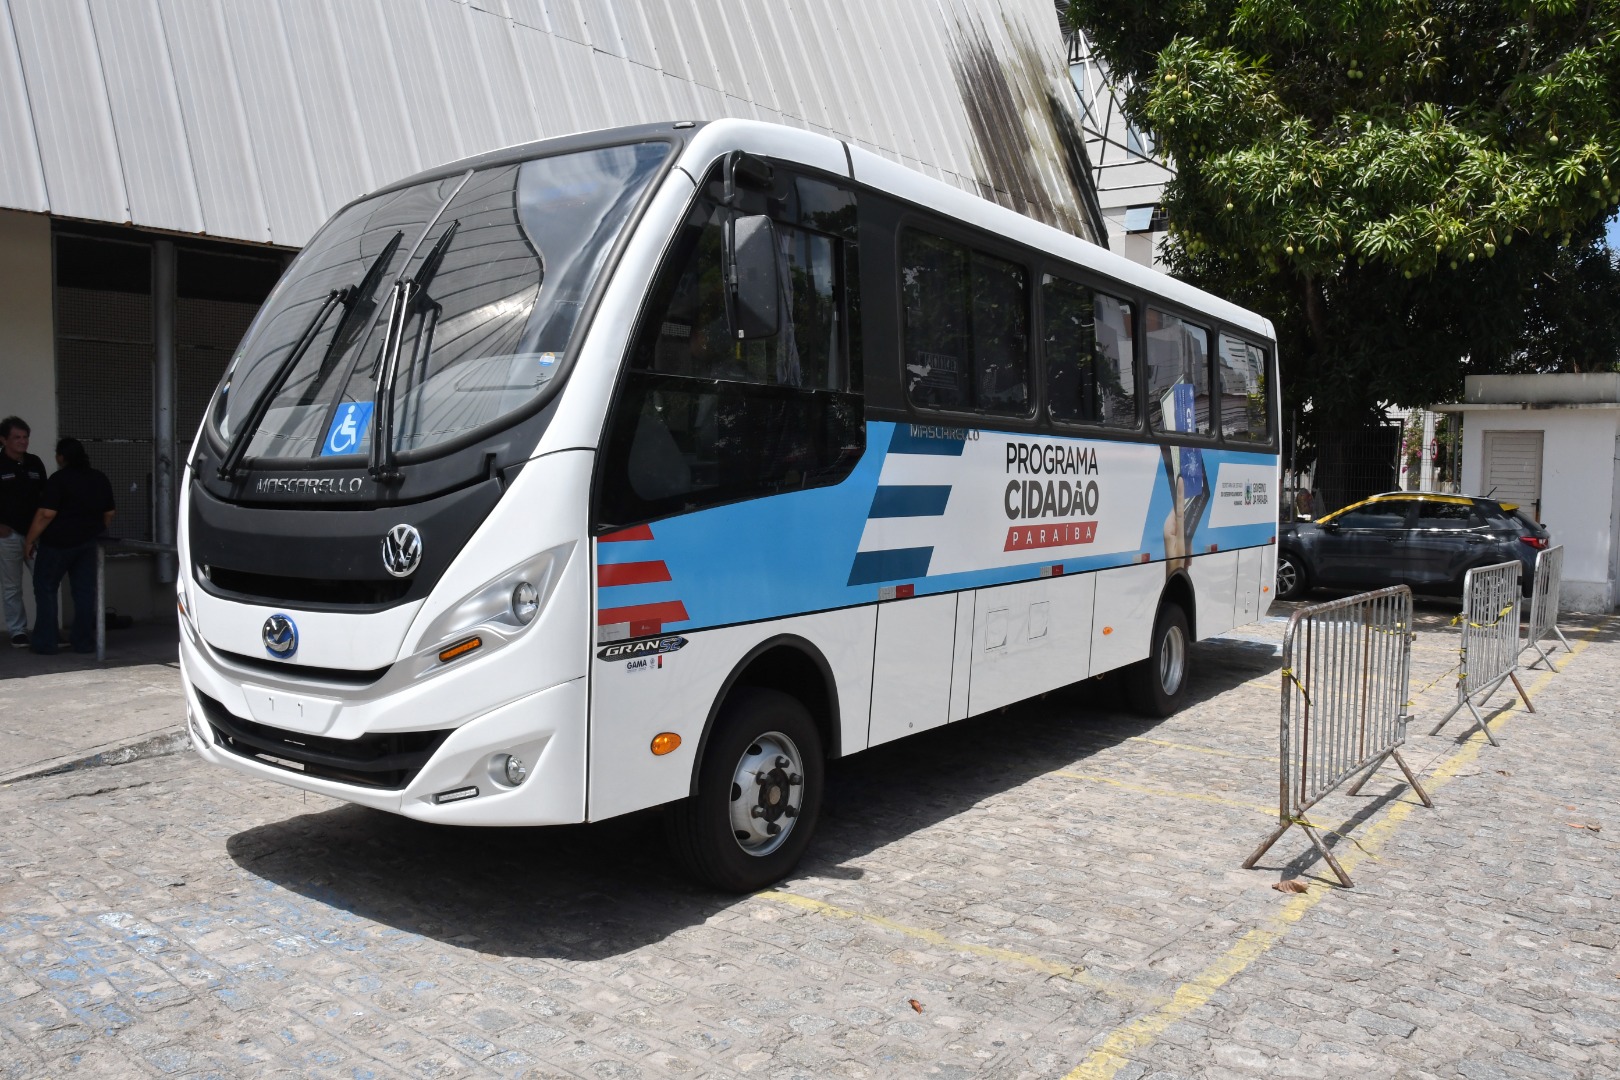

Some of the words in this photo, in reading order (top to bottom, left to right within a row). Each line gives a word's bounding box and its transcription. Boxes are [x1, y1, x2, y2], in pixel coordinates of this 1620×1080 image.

[1006, 442, 1099, 475] PROGRAMA
[255, 477, 363, 494] MASCARELLO
[1004, 479, 1099, 520] CIDADÃO
[1012, 523, 1091, 546] PARAÍBA
[382, 523, 423, 578] VW
[606, 640, 659, 656] GRAN
[627, 660, 647, 669] GAMA
